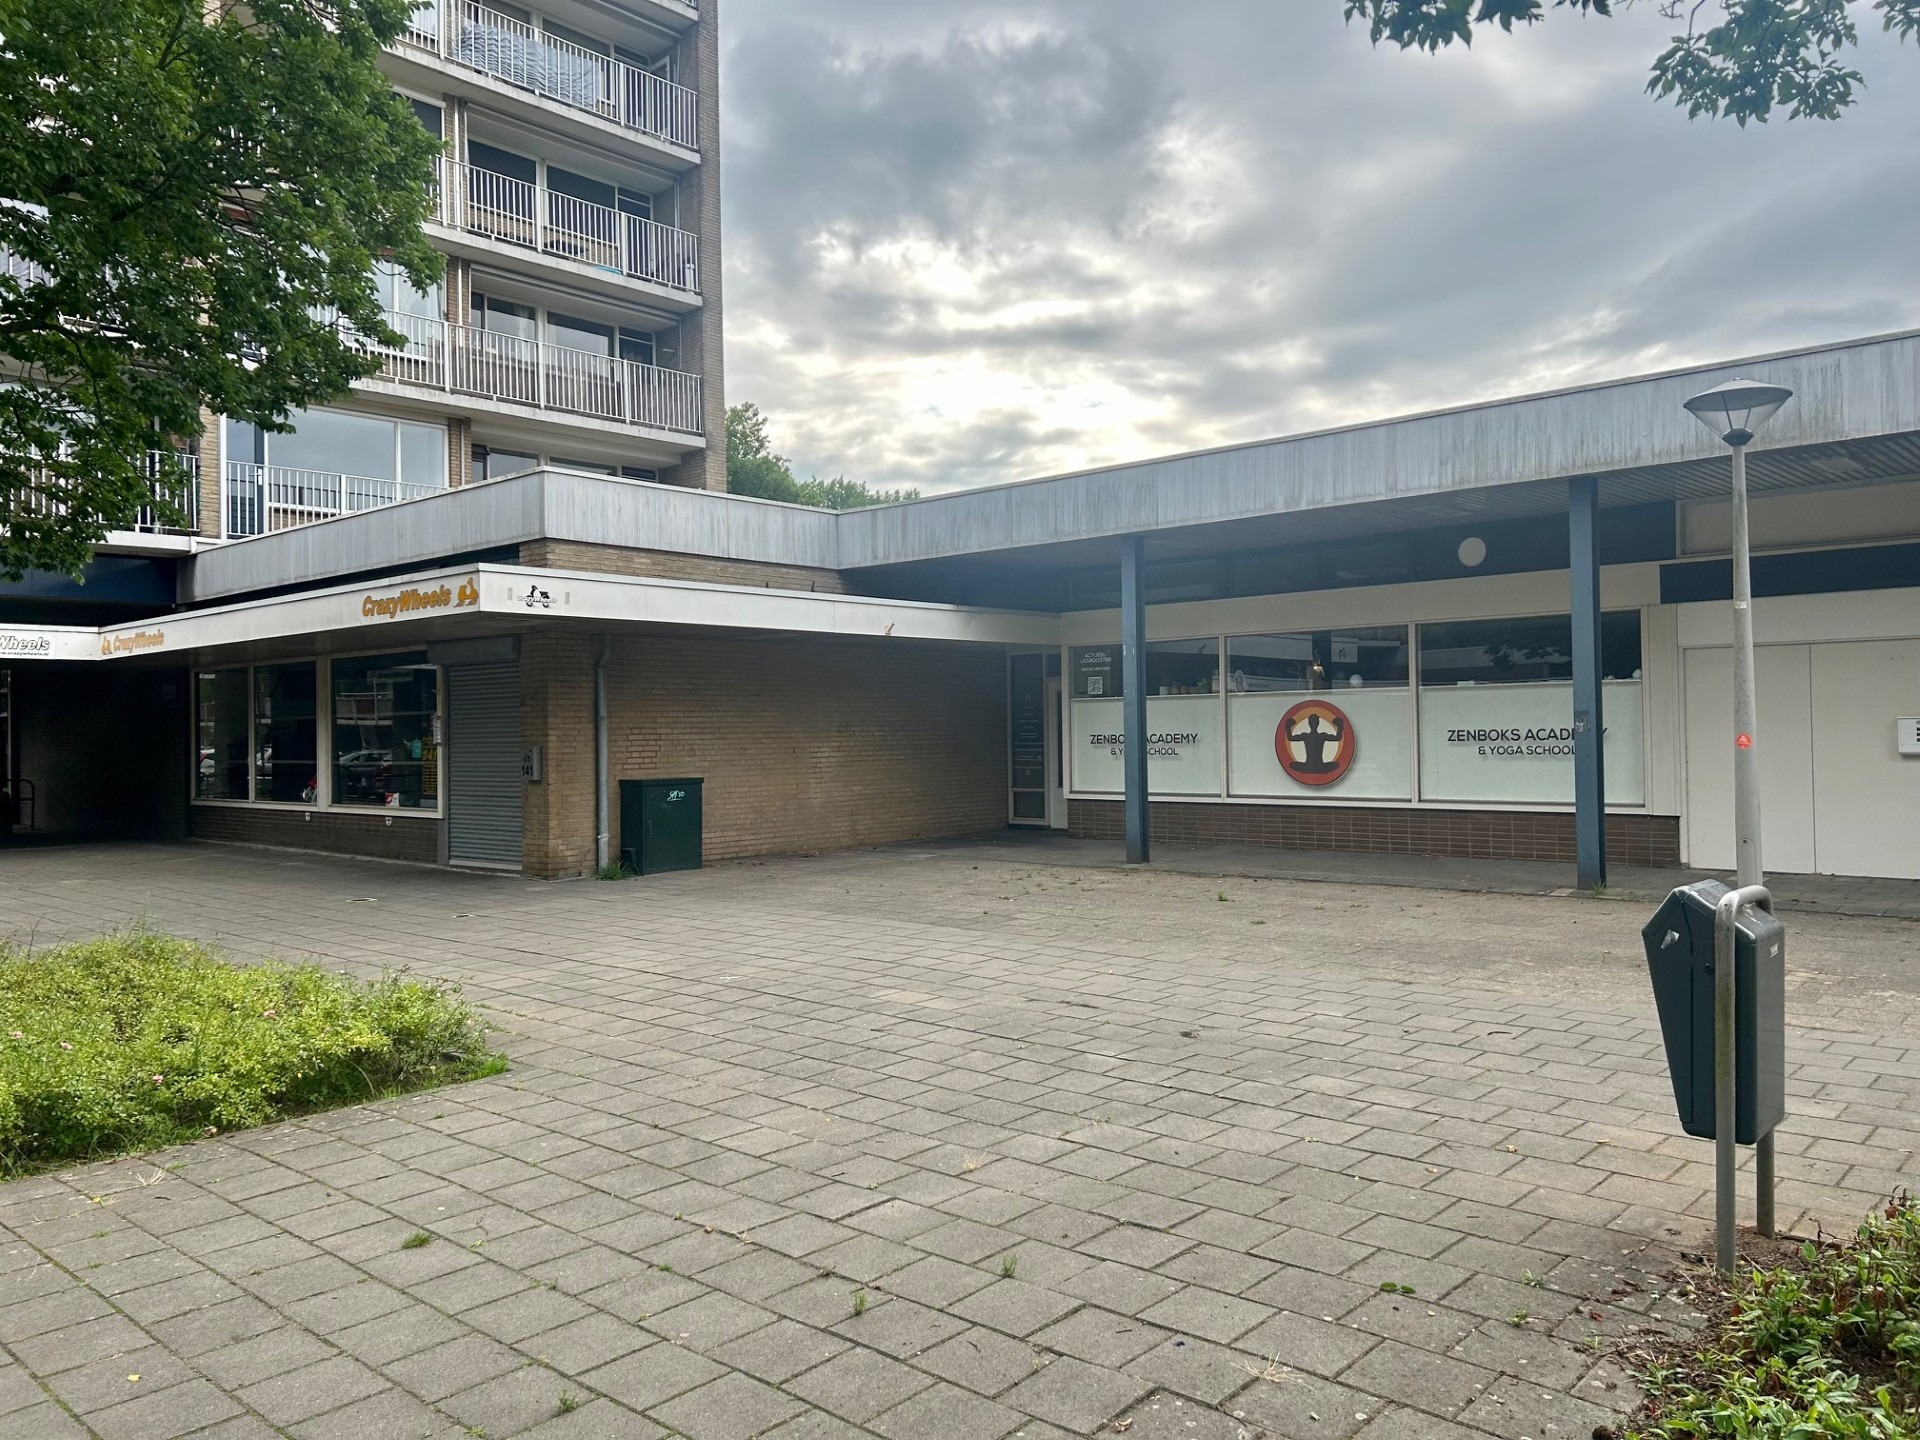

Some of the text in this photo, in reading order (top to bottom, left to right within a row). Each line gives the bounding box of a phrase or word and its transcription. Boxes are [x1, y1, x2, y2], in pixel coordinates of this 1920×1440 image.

[362, 584, 451, 618] CrazyWheels
[113, 629, 165, 653] CrazyWheels
[1090, 734, 1125, 744] ZENBO
[1447, 727, 1608, 742] ZENBOKS ACAD
[1110, 747, 1117, 756] &
[1478, 746, 1486, 755] &
[1489, 745, 1524, 755] YOGA
